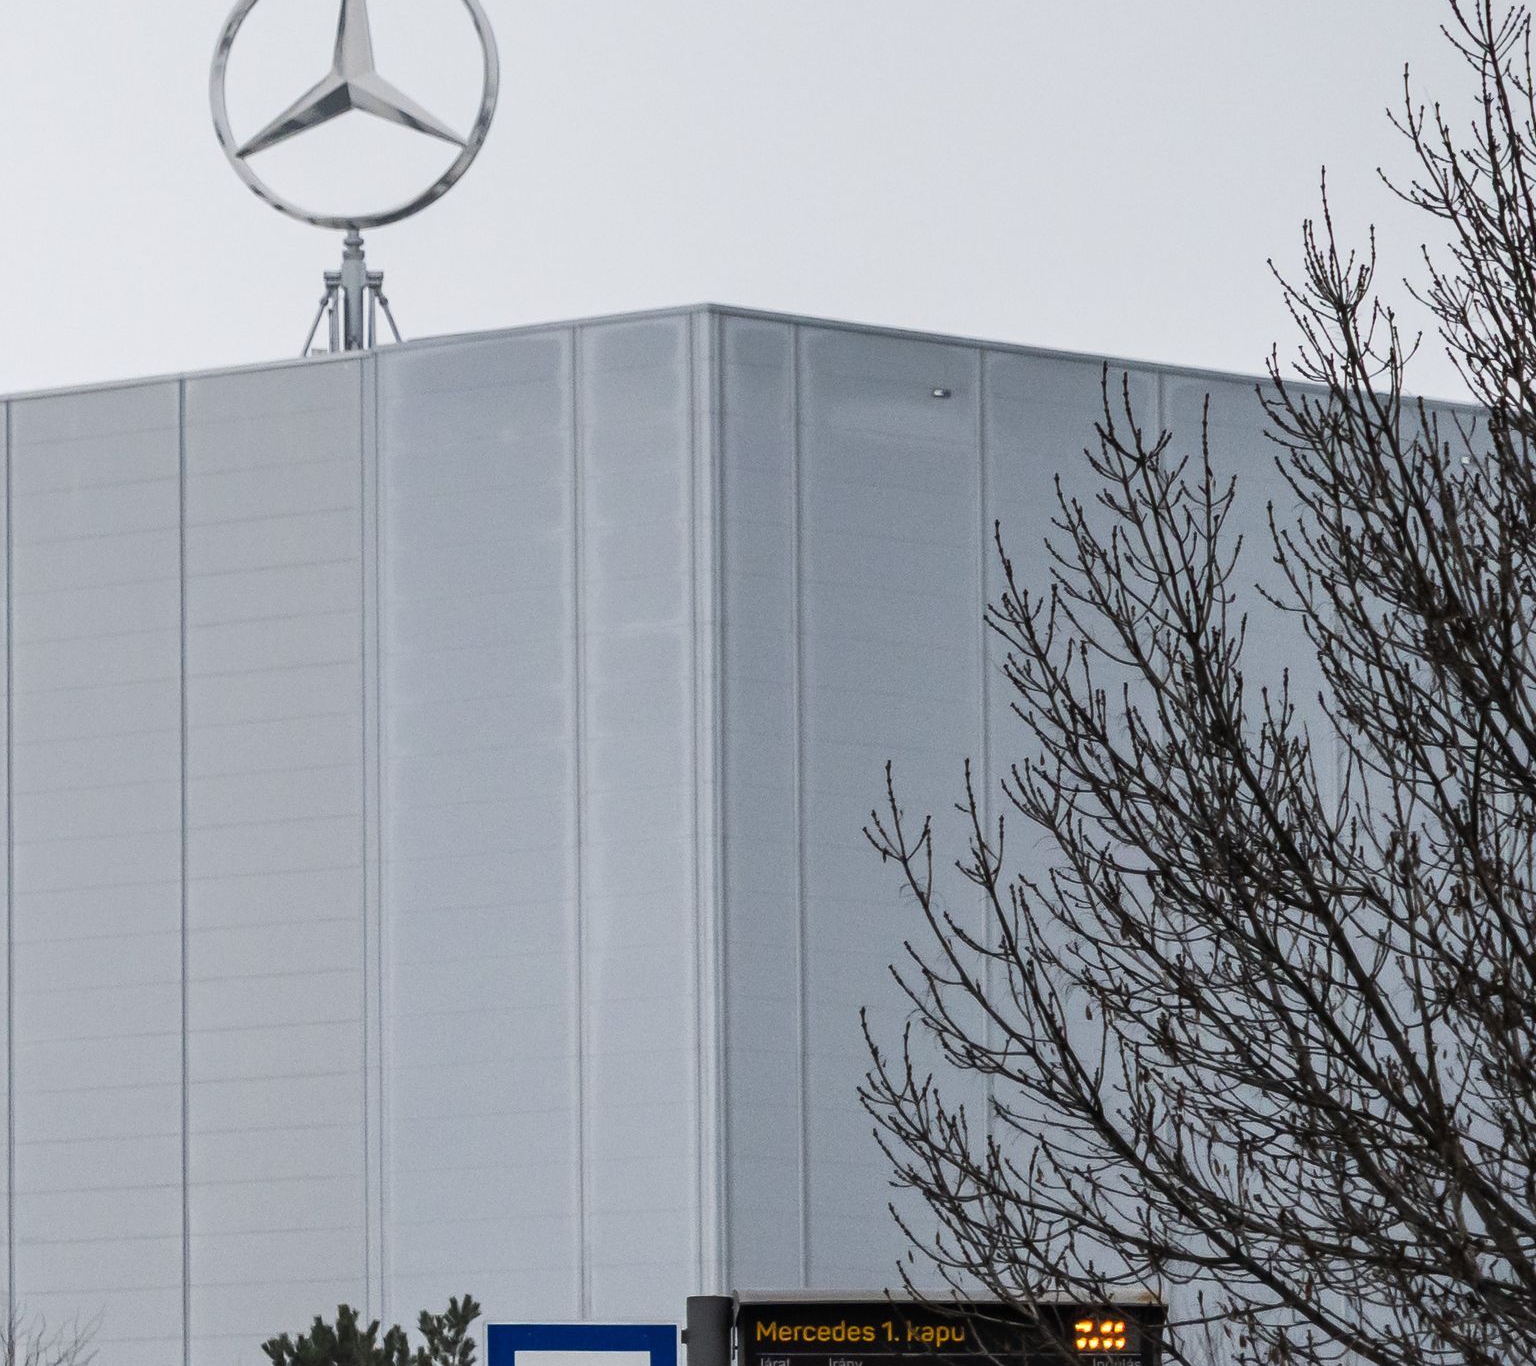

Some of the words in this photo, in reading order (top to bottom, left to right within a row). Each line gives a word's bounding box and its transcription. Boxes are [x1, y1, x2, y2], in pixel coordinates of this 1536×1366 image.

[756, 1320, 876, 1343] Mercedes
[882, 1321, 900, 1343] 1.
[907, 1319, 966, 1348] kapu
